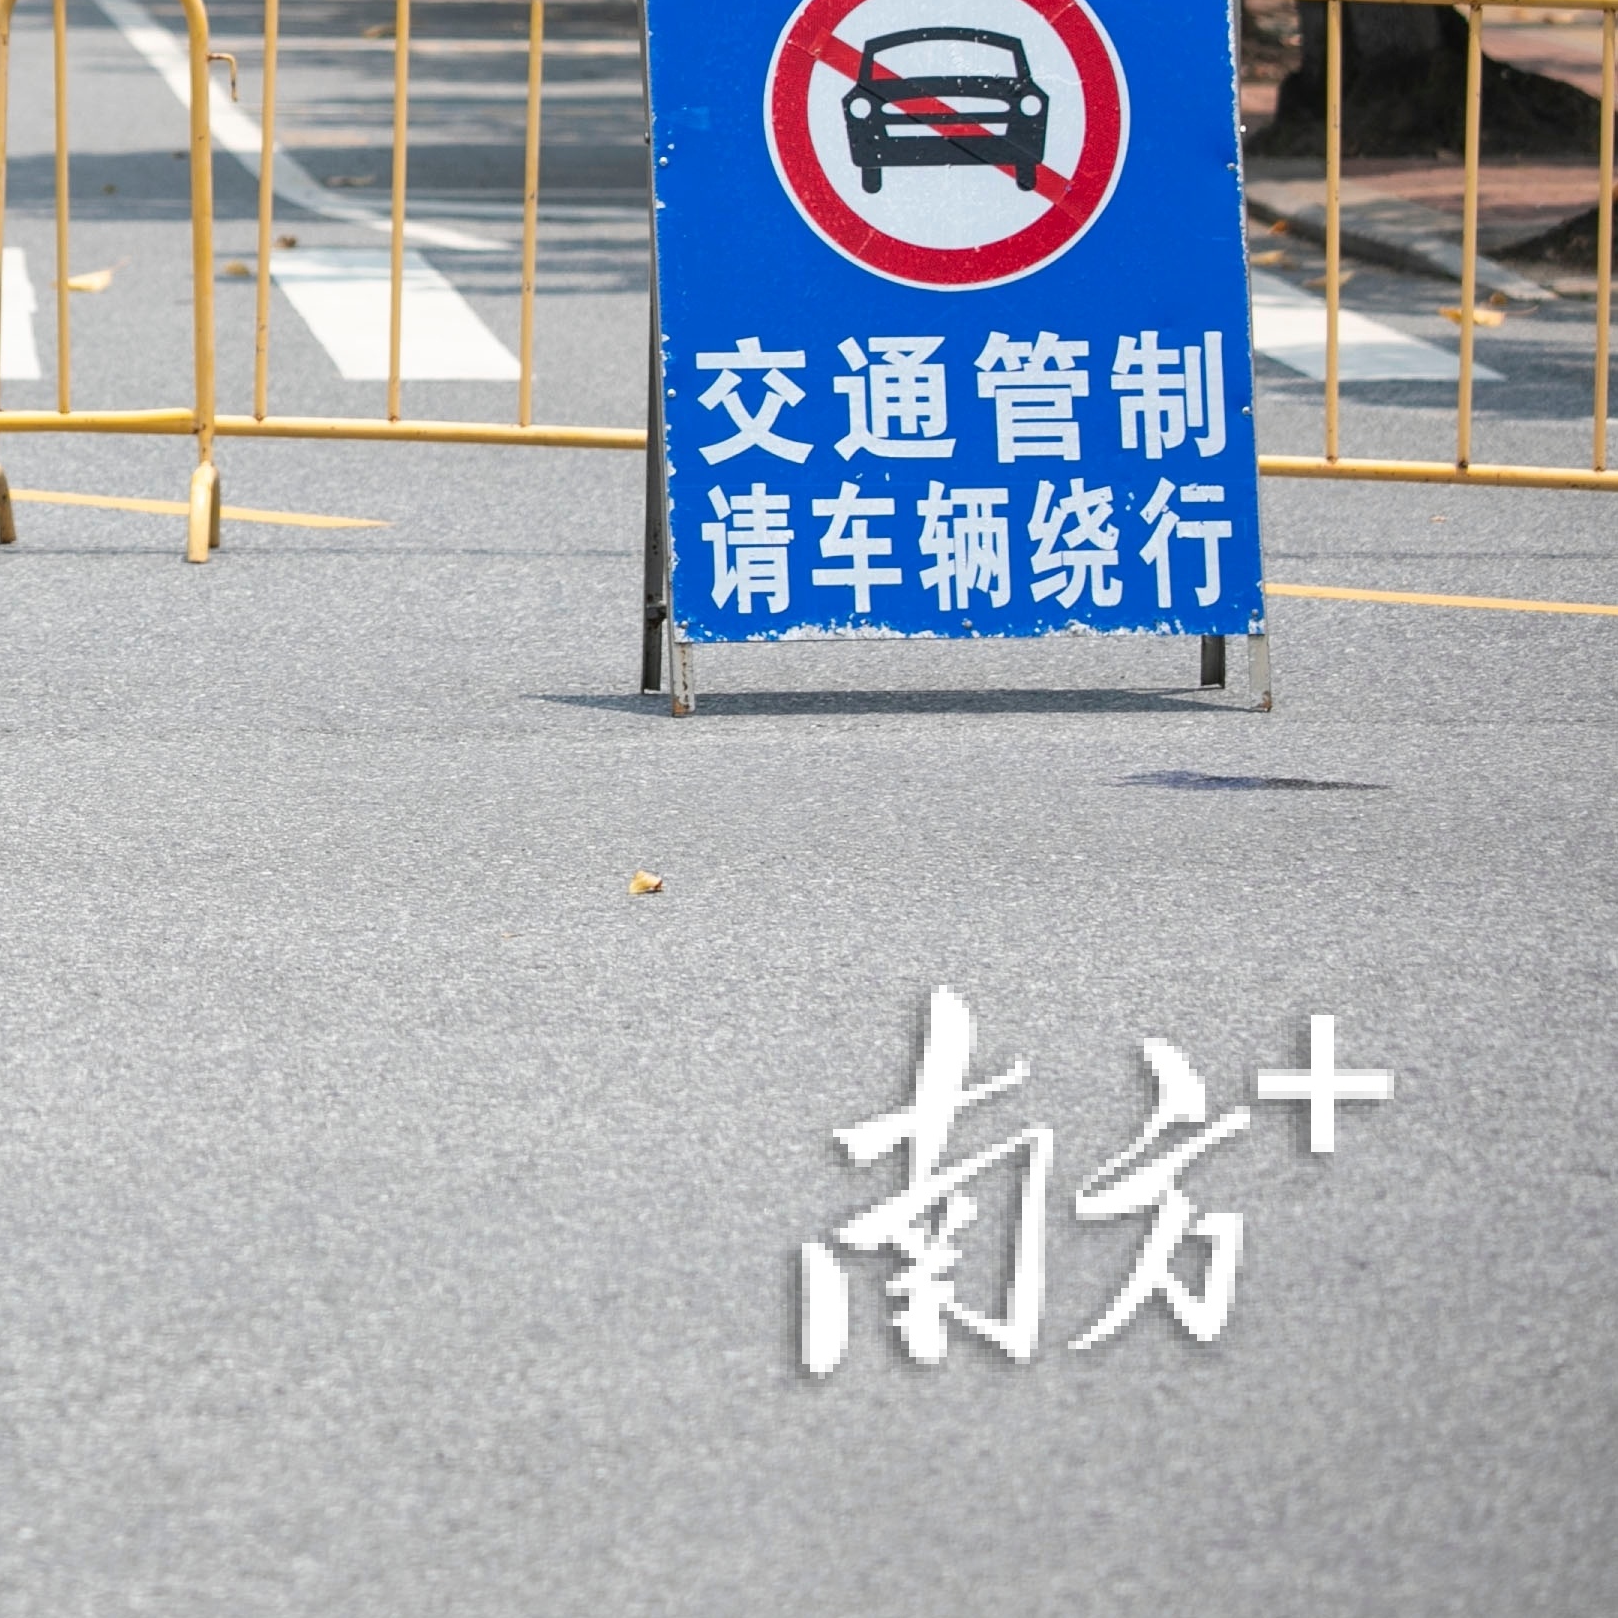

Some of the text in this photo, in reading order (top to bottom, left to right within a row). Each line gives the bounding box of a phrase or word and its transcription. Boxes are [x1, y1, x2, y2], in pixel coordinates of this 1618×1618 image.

[696, 330, 1228, 465] 交通管制
[700, 478, 1232, 614] 请车辆绕行
